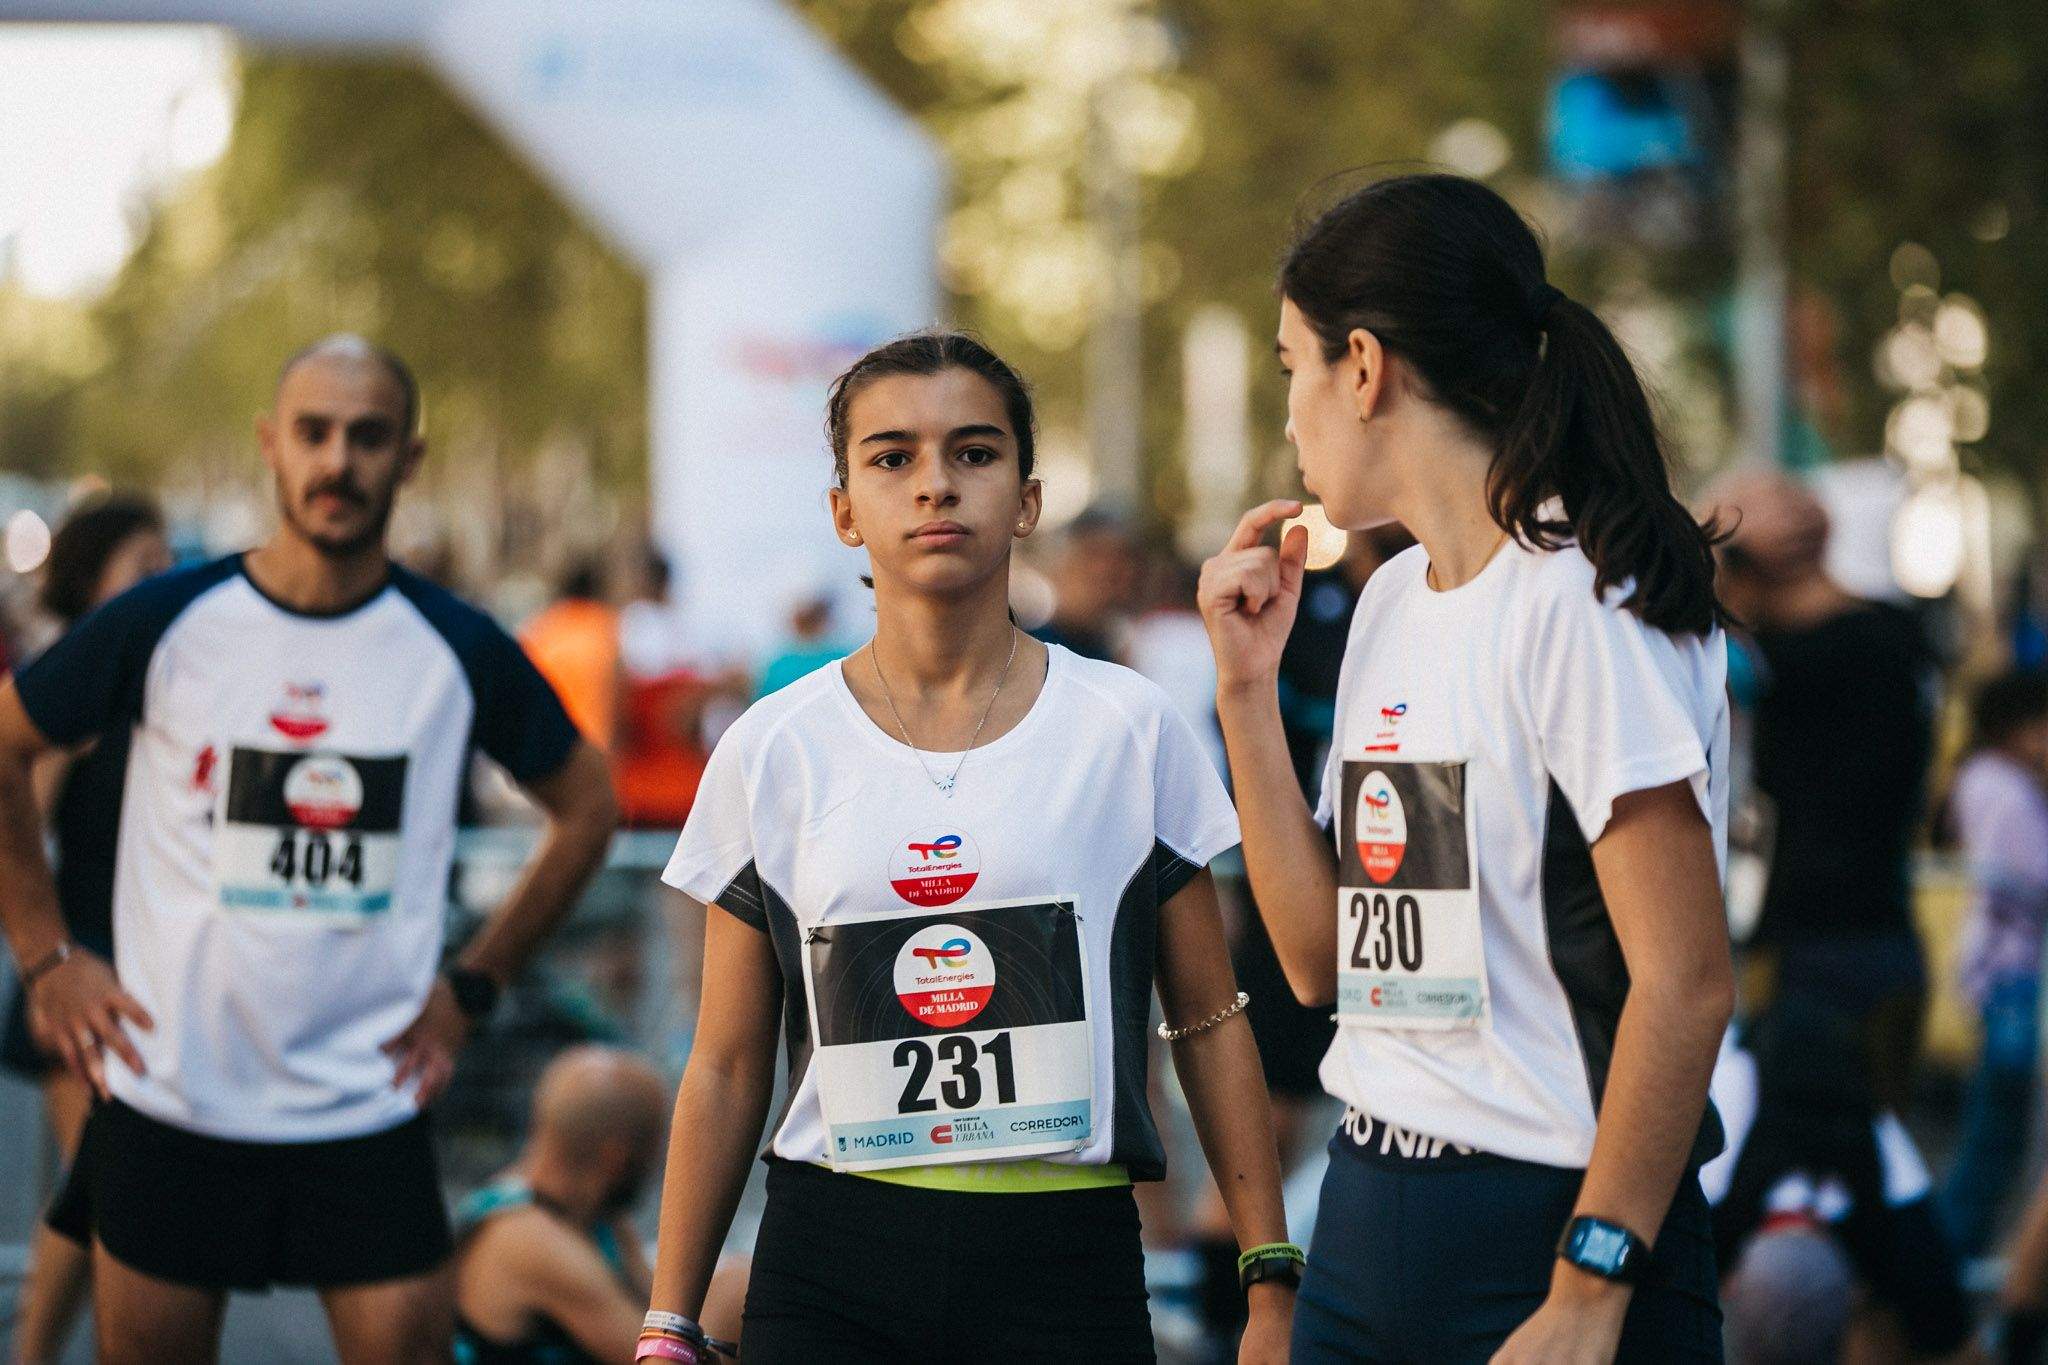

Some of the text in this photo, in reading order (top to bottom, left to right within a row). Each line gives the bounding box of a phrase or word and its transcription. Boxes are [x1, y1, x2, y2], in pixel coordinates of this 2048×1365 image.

[270, 829, 363, 884] 404
[908, 863, 962, 873] TotalEnergies
[921, 879, 951, 887] MILLA
[908, 887, 964, 898] DE MADRID
[1350, 892, 1424, 972] 230
[915, 972, 975, 985] TotalEnergies
[931, 991, 965, 1003] MILLA
[919, 1001, 979, 1016] DE MADRID
[893, 1032, 1017, 1114] 231
[955, 1121, 988, 1132] MILLA
[854, 1132, 914, 1149] MADRID
[955, 1131, 994, 1143] URBANA
